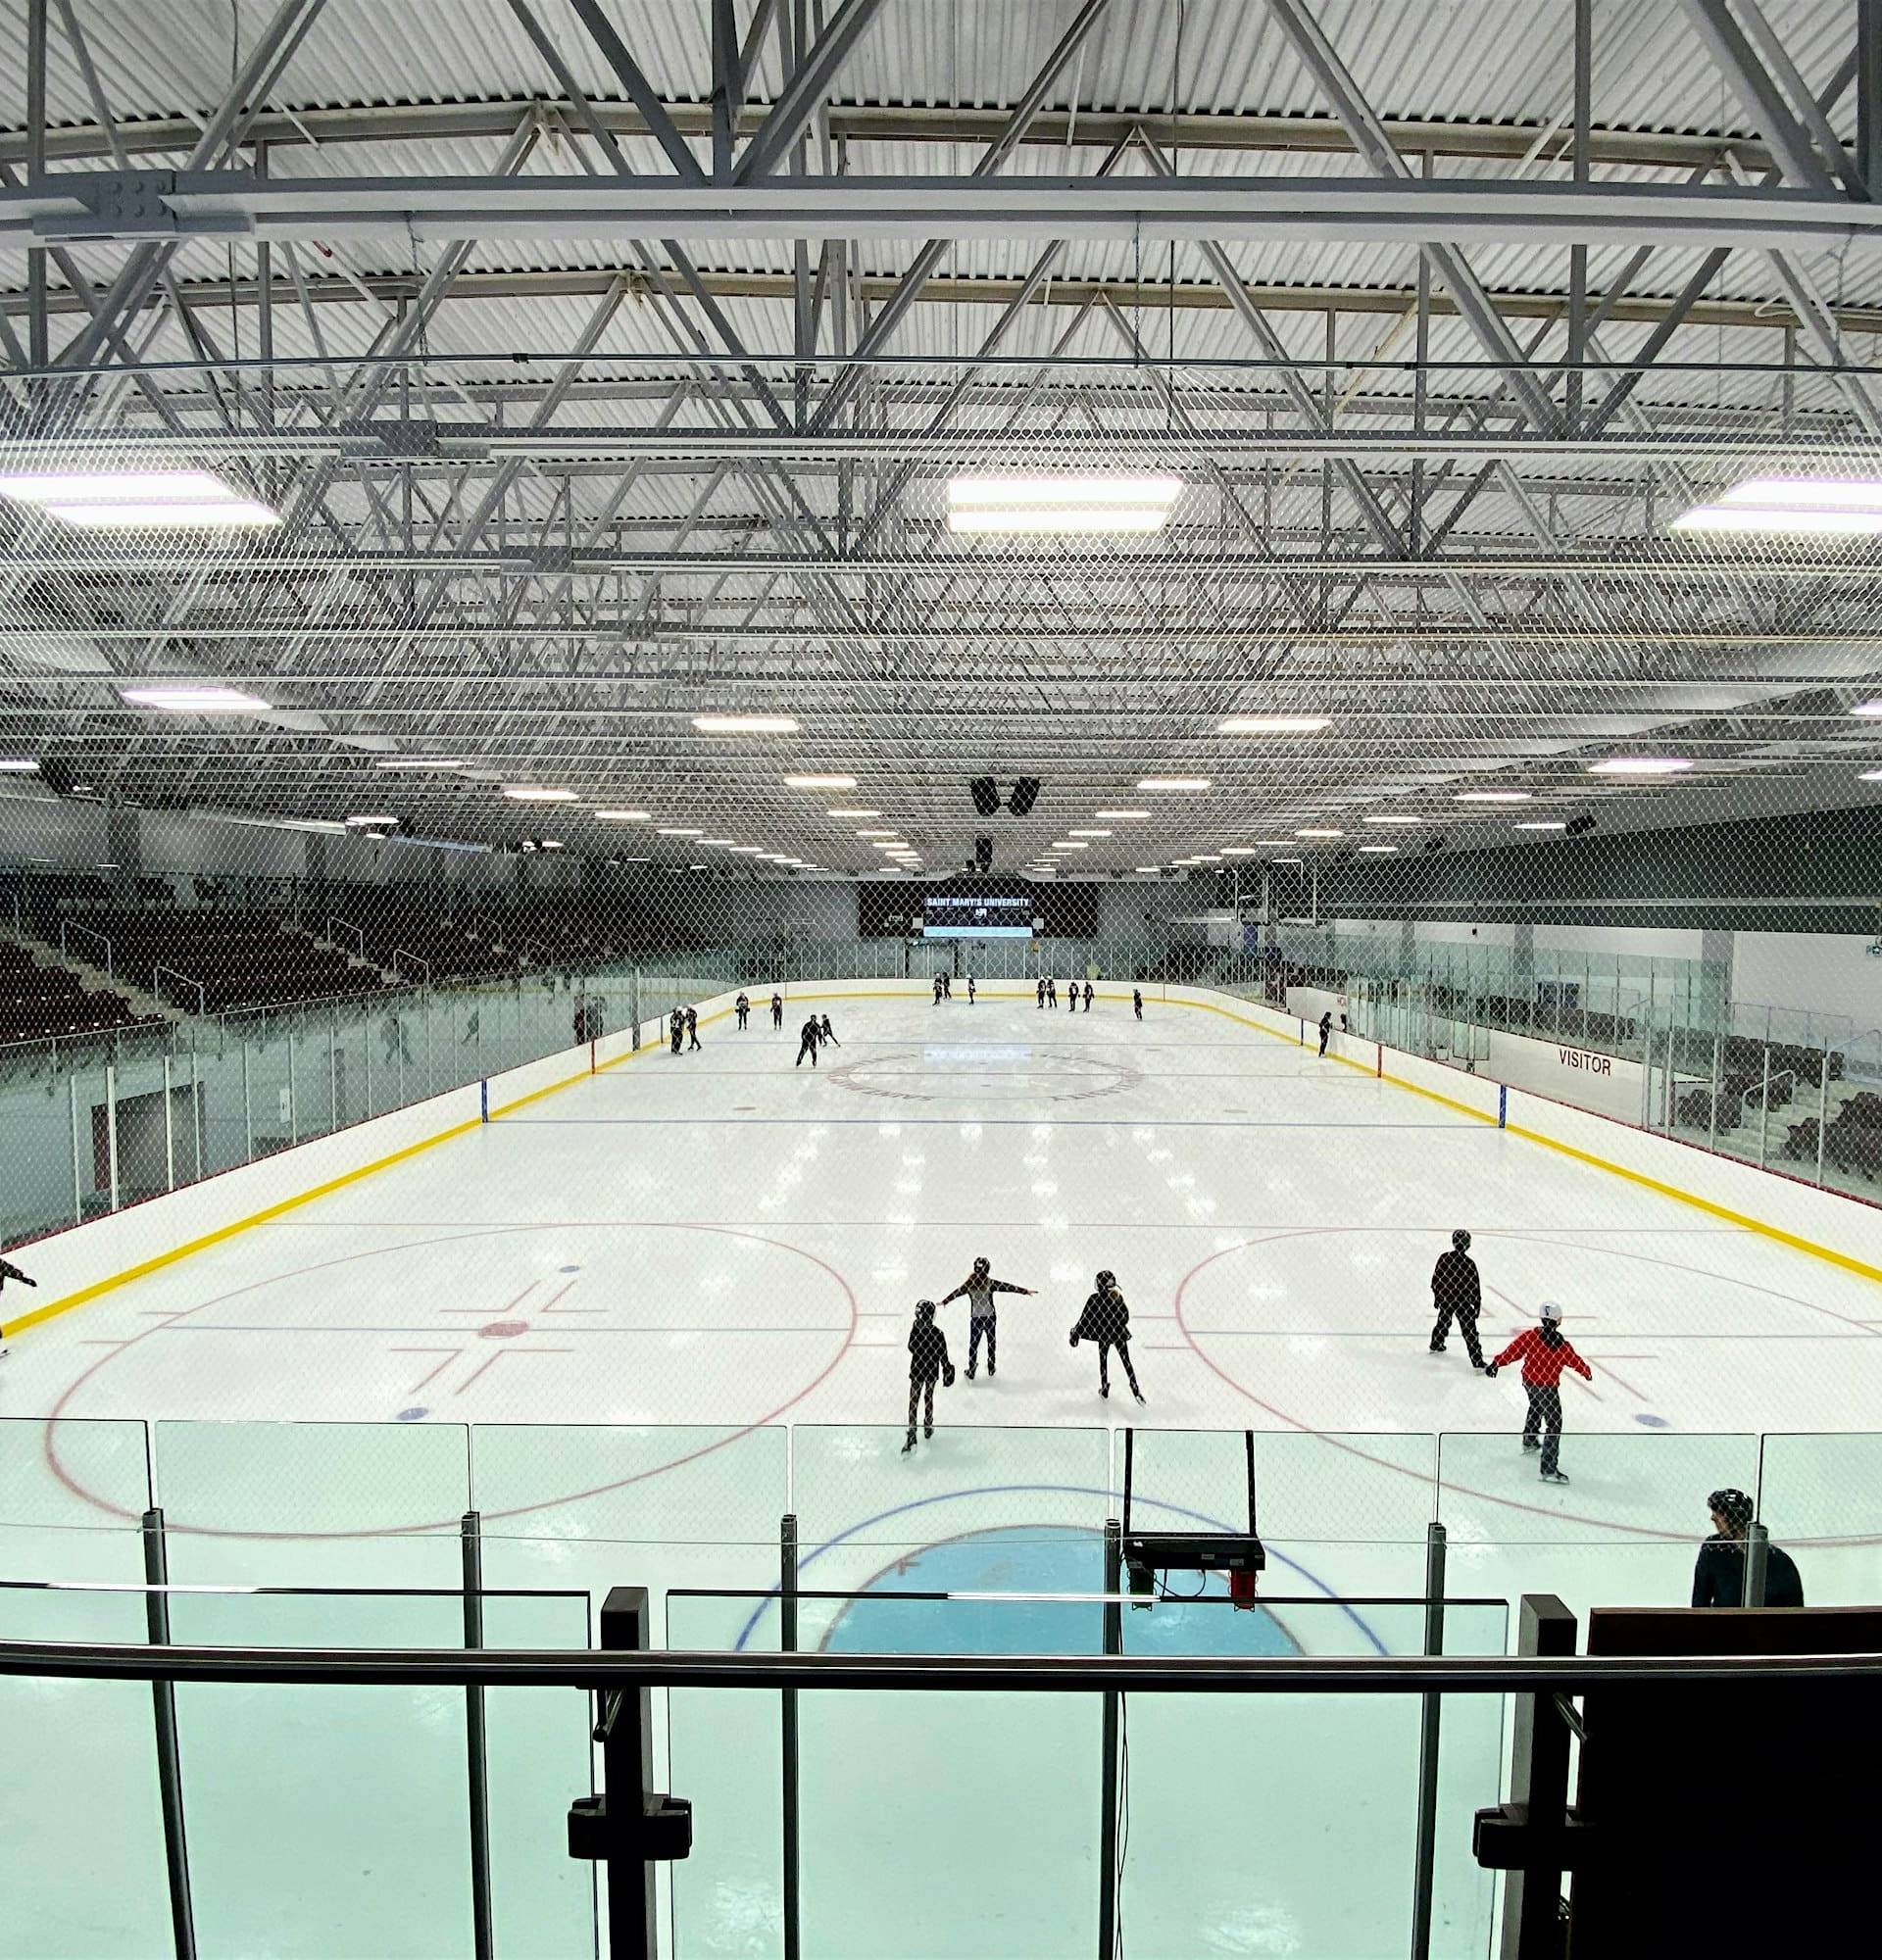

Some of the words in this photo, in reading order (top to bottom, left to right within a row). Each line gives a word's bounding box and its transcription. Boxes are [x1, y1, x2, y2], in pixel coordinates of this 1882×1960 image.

[927, 898, 950, 906] SAINT
[952, 898, 982, 906] MARY'S
[984, 898, 1029, 906] UNIVERSITY
[1560, 1049, 1611, 1076] VISITOR
